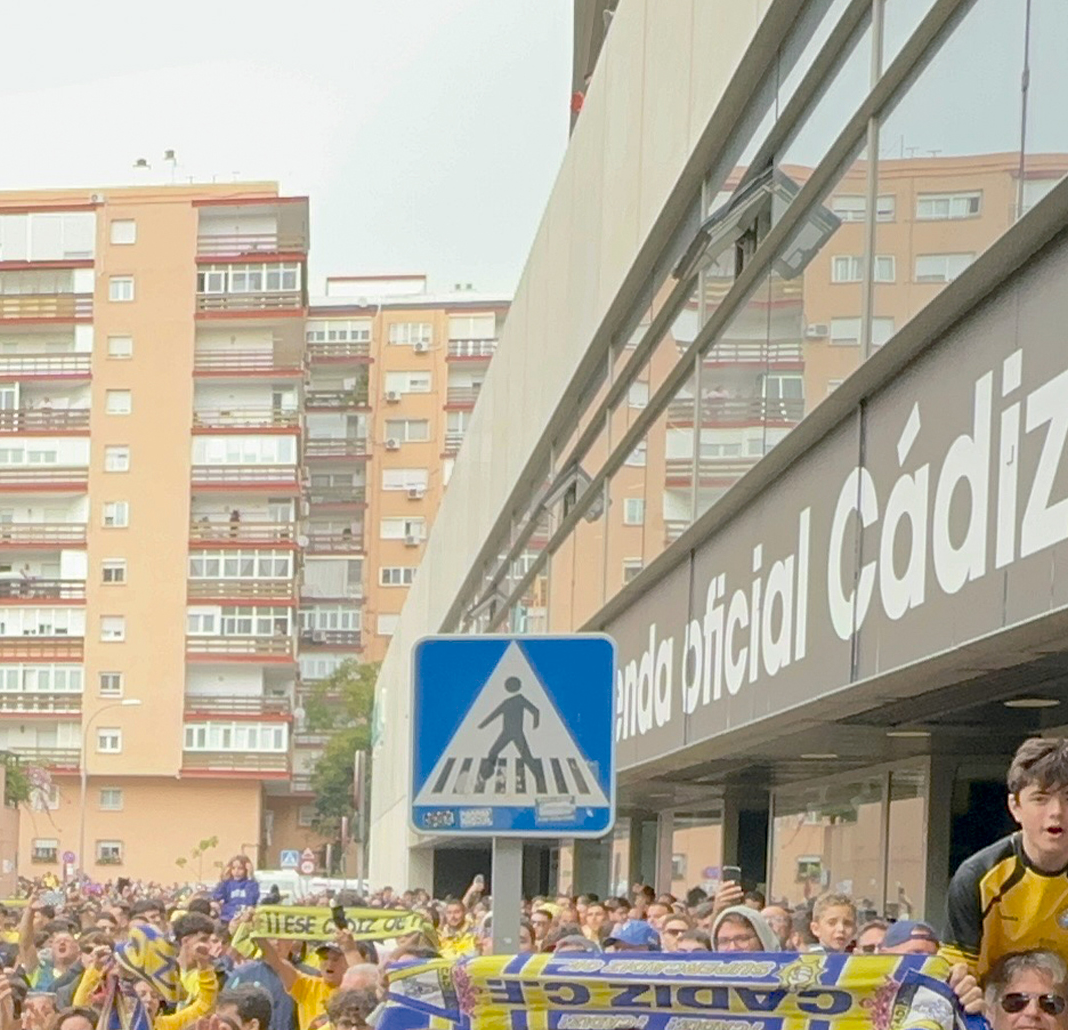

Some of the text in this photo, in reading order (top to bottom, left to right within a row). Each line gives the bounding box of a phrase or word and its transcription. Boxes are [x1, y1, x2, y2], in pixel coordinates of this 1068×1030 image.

[682, 507, 811, 714] oficial
[828, 348, 1068, 640] Cádiz
[323, 917, 377, 934] CDIZ
[608, 985, 852, 1015] CADIZ
